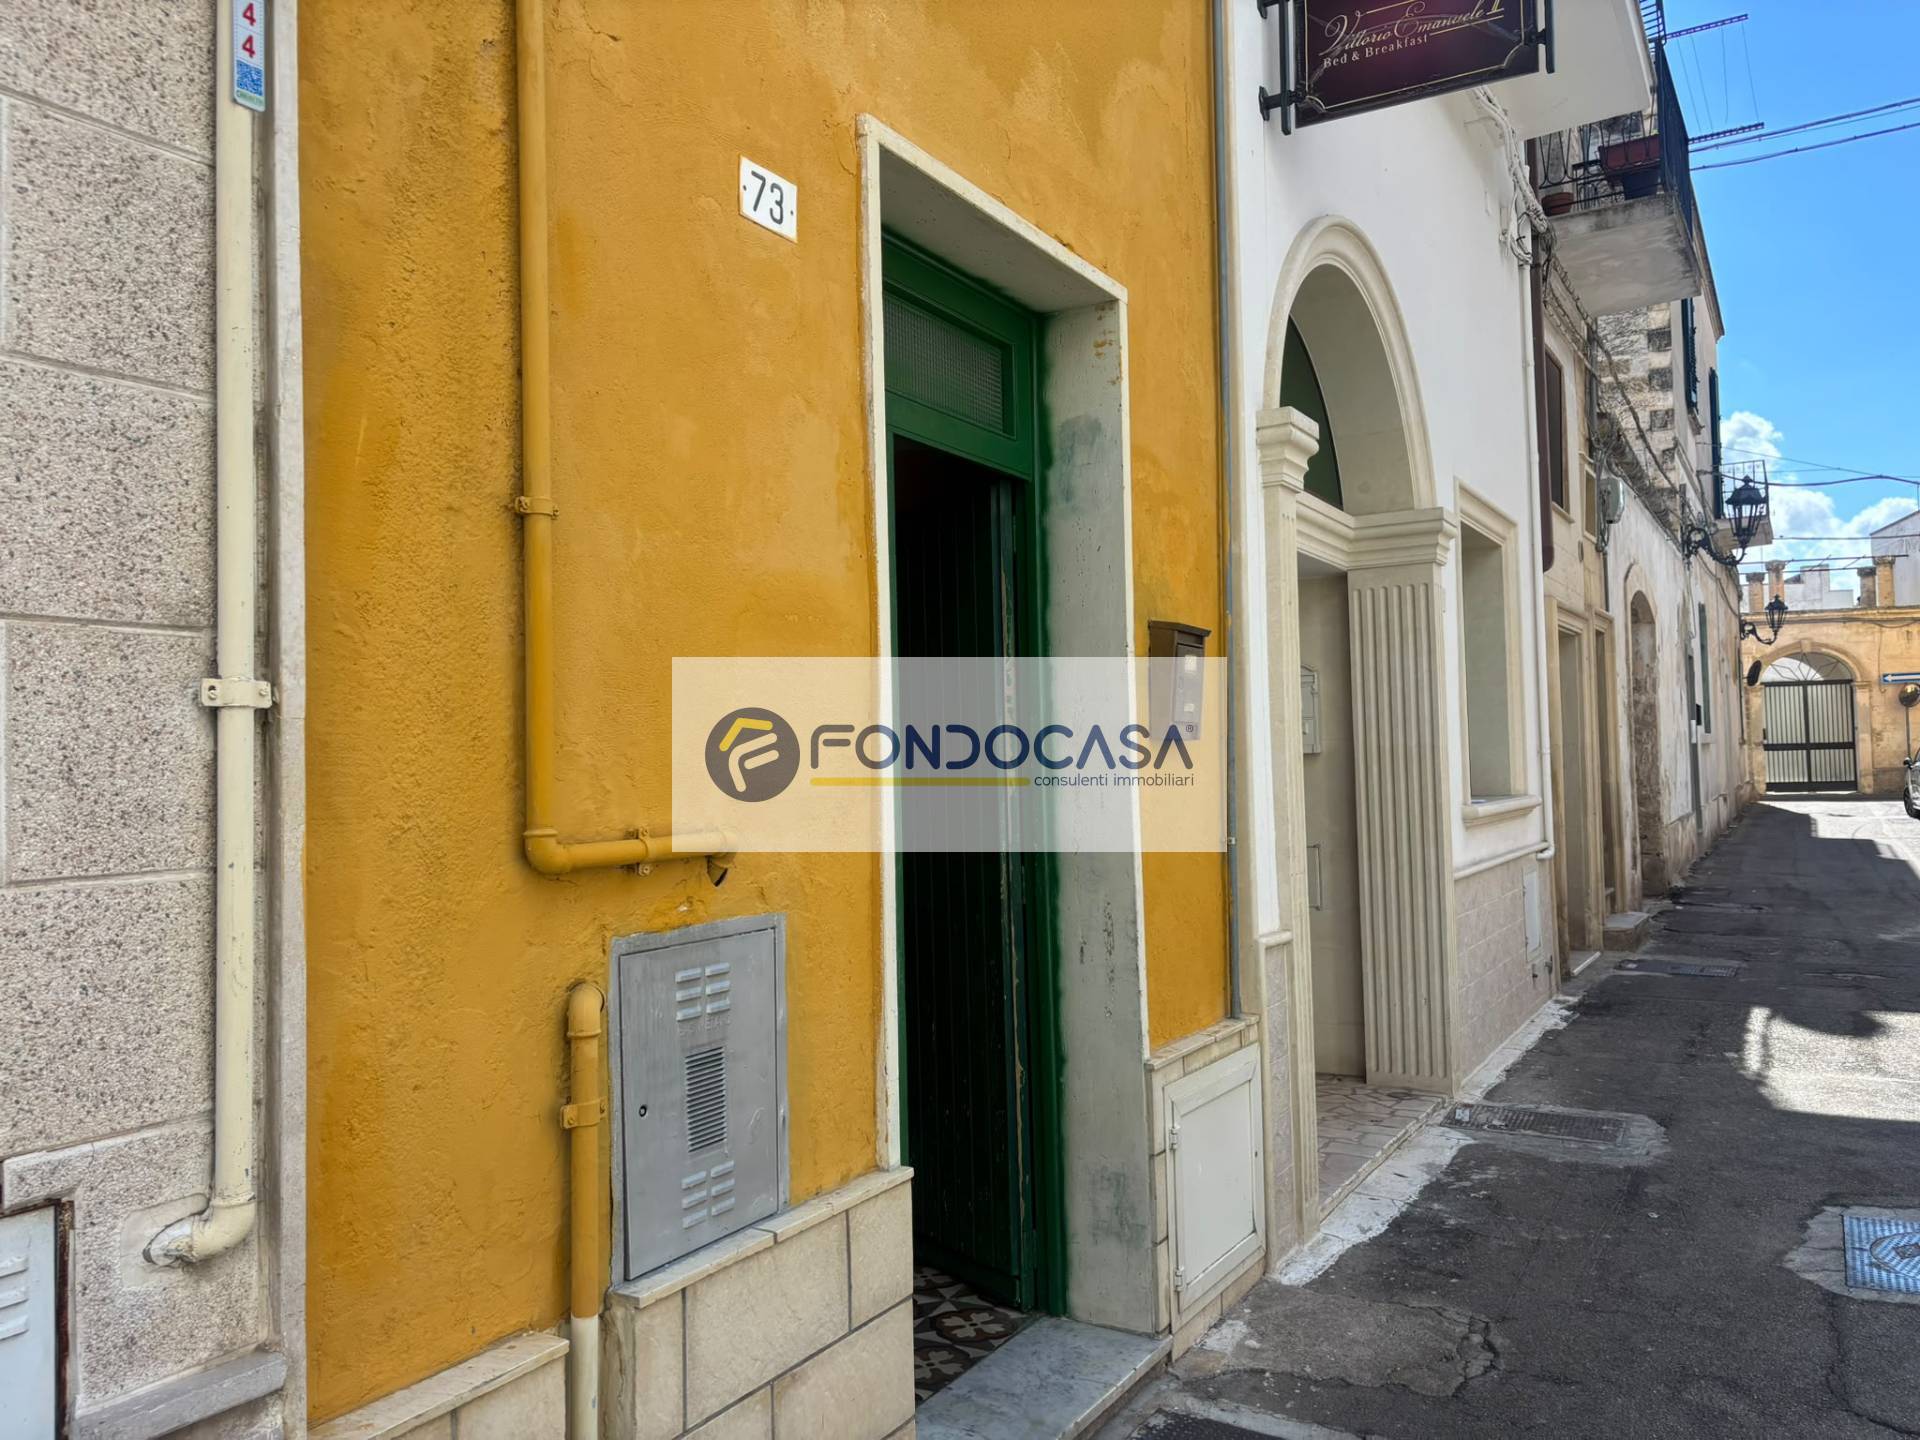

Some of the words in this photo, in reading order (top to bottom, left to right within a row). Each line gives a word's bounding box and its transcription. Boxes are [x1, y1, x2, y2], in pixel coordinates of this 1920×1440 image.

[1319, 10, 1392, 56] Vittorio
[1394, 0, 1485, 38] Emanuele
[1323, 53, 1348, 68] Bed
[1351, 50, 1361, 61] &
[1365, 34, 1428, 58] Breakfast
[751, 170, 784, 225] 73
